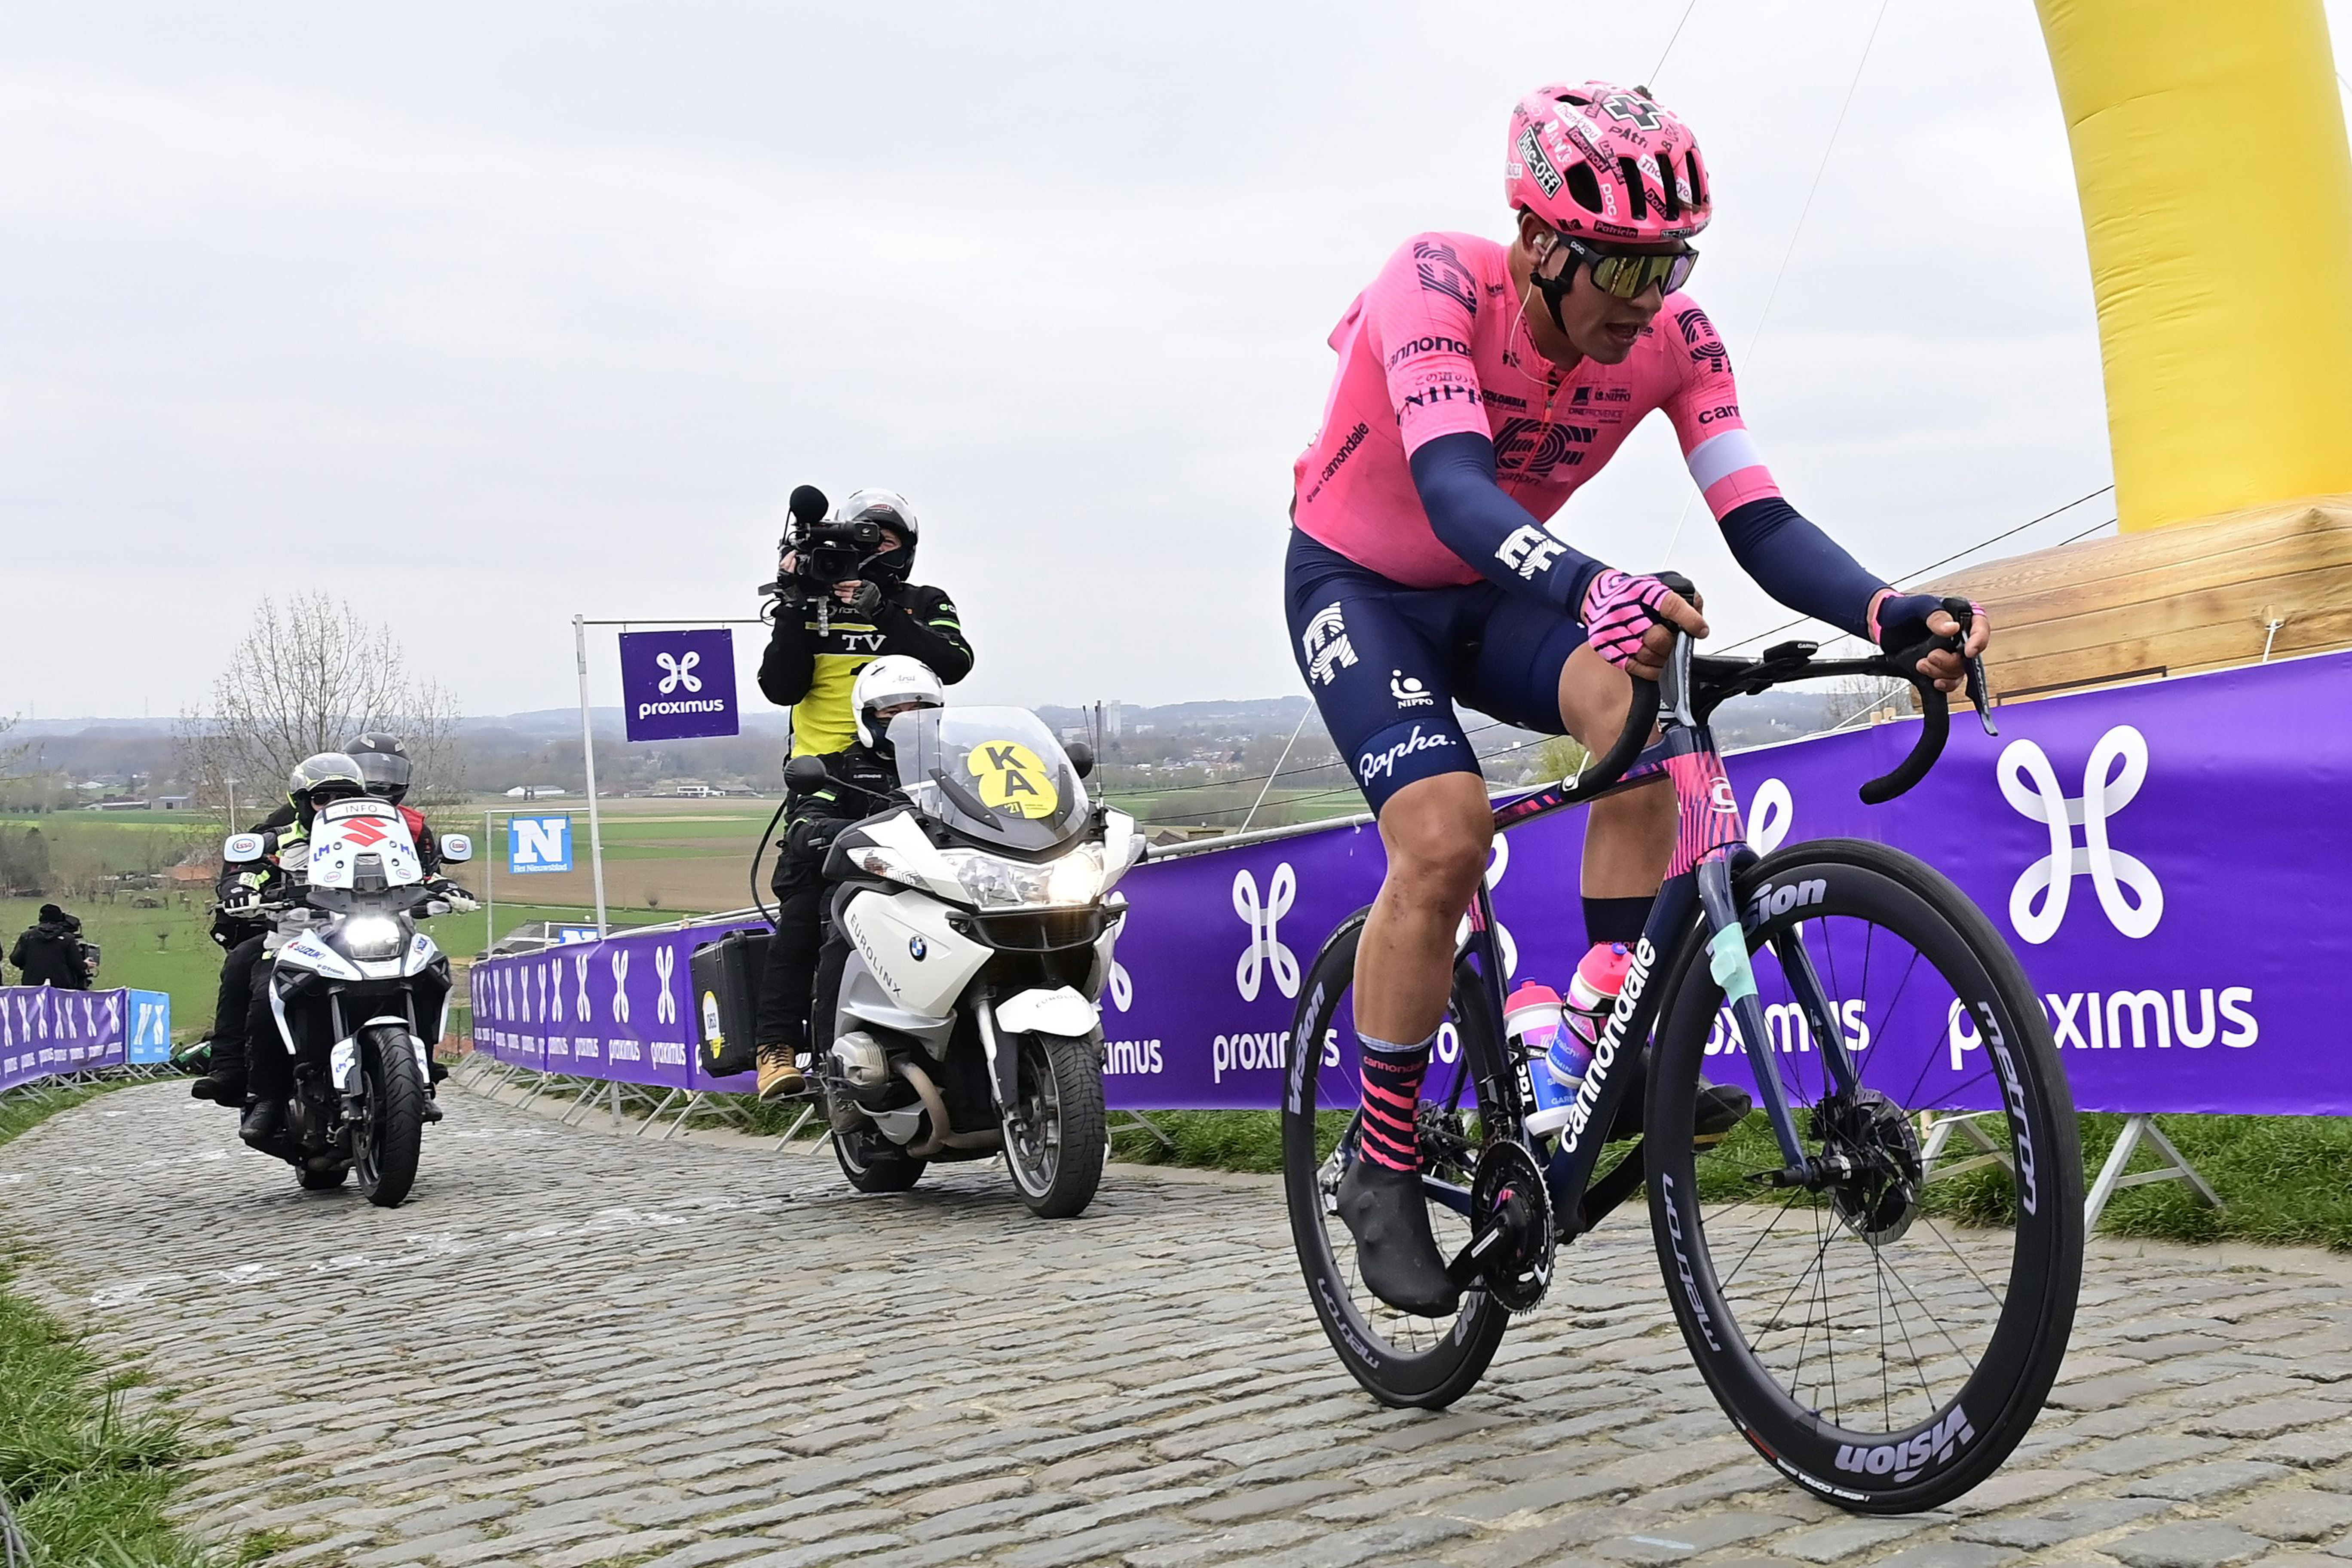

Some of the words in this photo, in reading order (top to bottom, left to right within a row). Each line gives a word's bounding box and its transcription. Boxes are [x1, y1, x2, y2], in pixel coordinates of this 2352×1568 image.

[1605, 392, 1631, 402] NIPPO
[1322, 422, 1369, 481] cannondale
[842, 634, 887, 651] TV
[639, 698, 724, 719] proximus
[1397, 698, 1434, 709] NIPPO
[345, 805, 377, 813] INFO
[513, 819, 566, 863] N
[294, 945, 326, 961] SUZUKI
[850, 913, 902, 998] EUROLINX
[1561, 937, 1656, 1153] cannondale
[1516, 1063, 1533, 1106] Tac
[1978, 1001, 2036, 1216] metron
[1662, 1172, 1722, 1352] metron
[1317, 1277, 1379, 1369] metron
[1834, 1403, 1975, 1483] Vision
